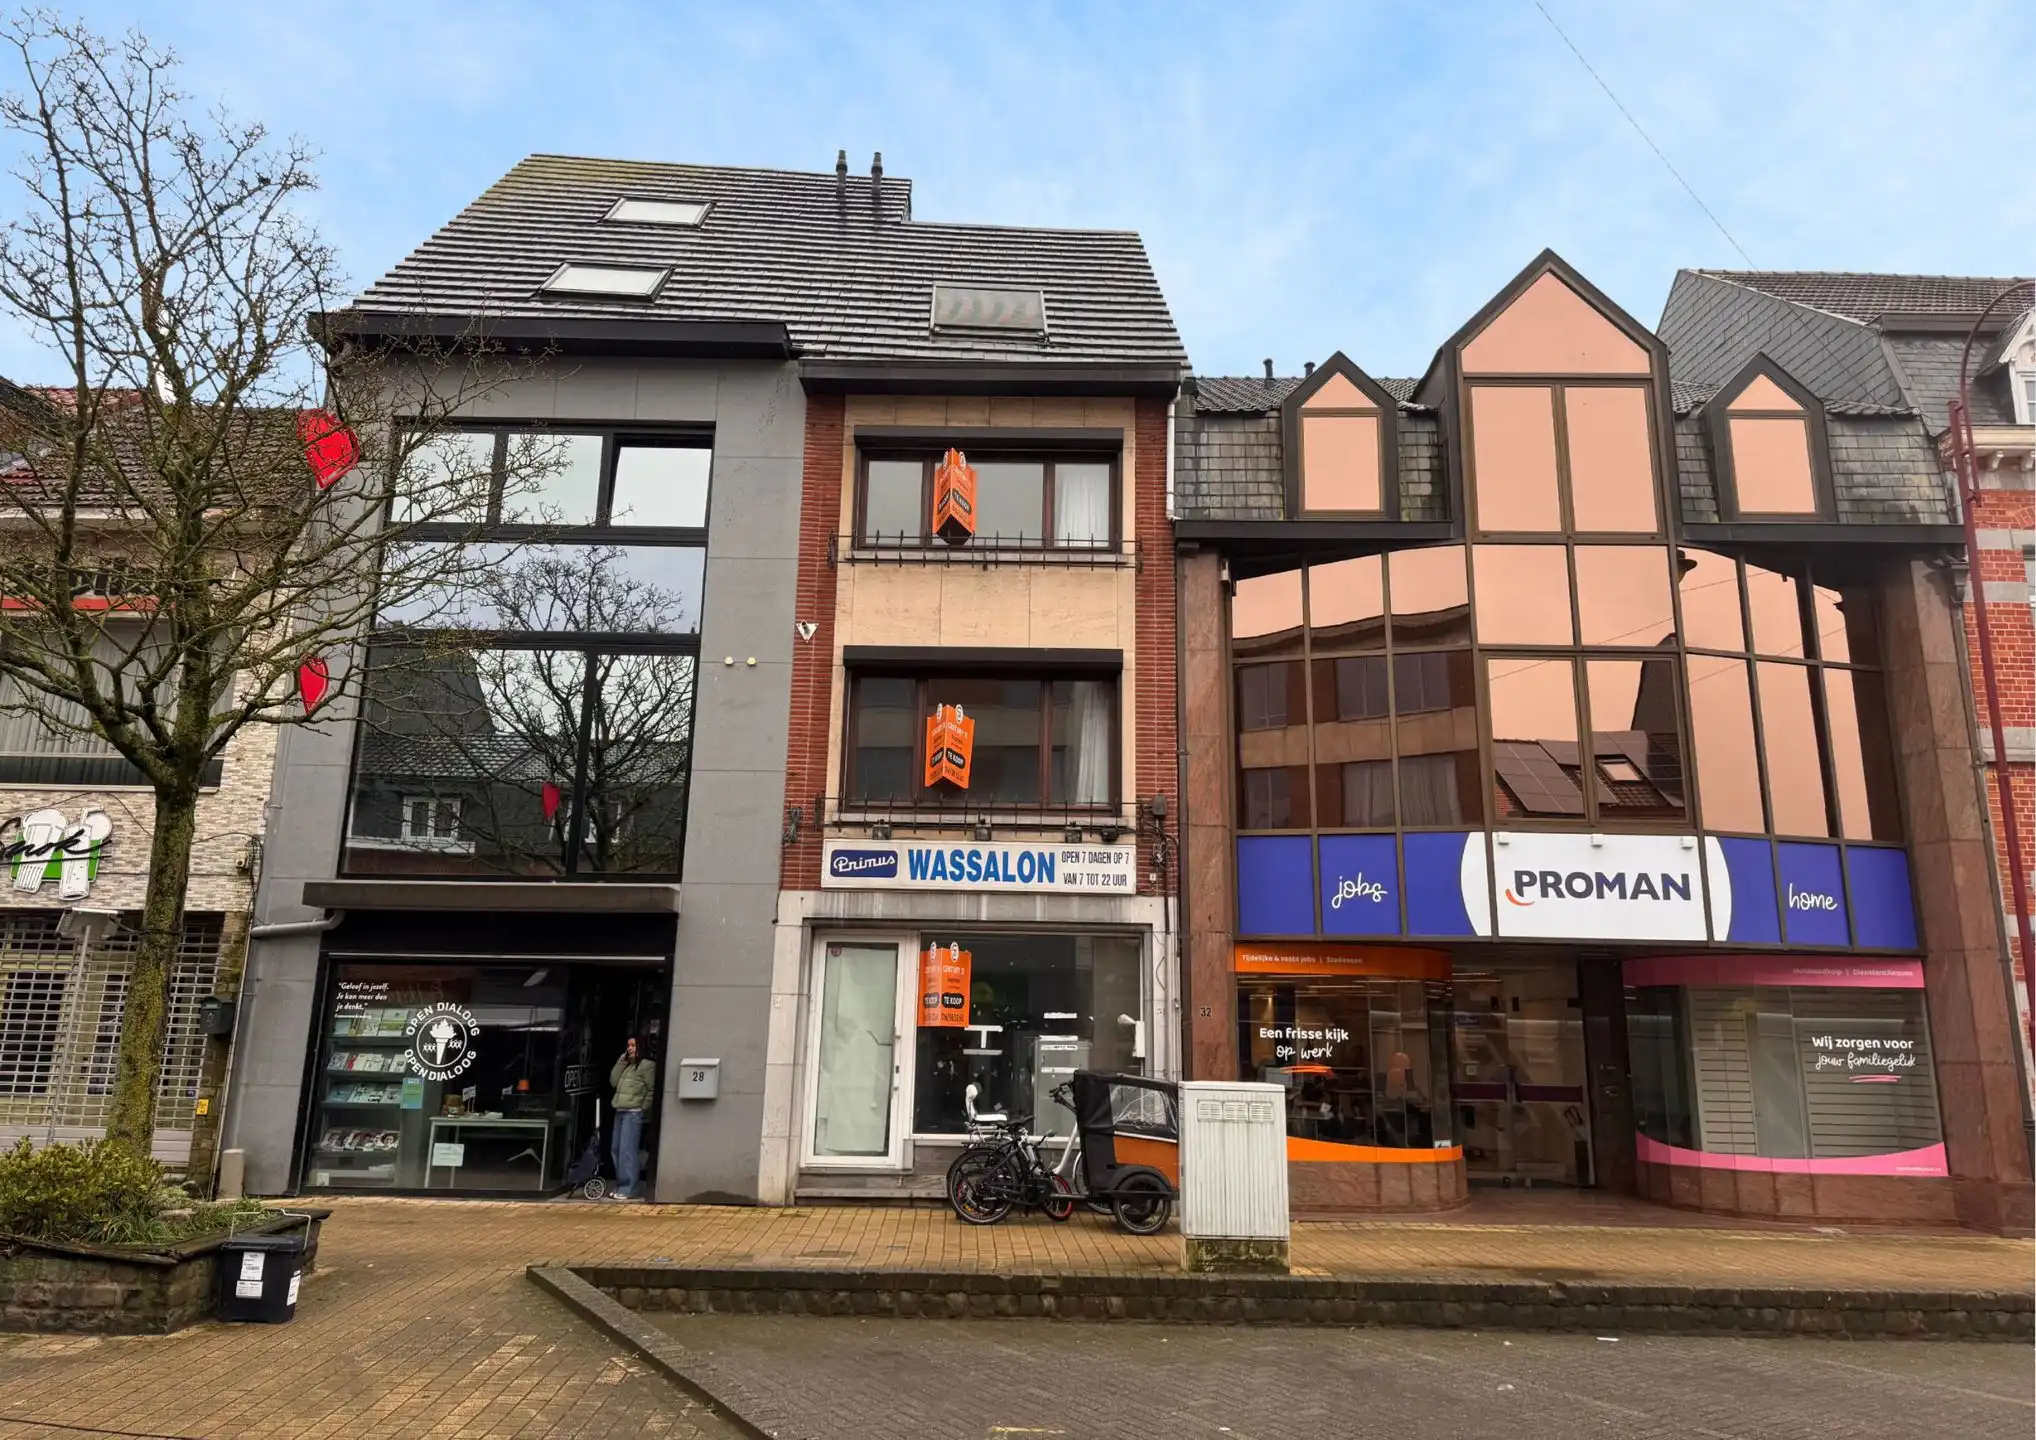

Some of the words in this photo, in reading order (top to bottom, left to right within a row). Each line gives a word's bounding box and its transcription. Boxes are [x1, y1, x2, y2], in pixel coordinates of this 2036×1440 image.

[833, 855, 896, 873] Primus
[908, 848, 1056, 883] WASSALON
[1061, 850, 1080, 864] OPEN
[1082, 851, 1087, 864] 7
[1088, 851, 1112, 864] DAGEN
[1113, 852, 1123, 864] OP
[1125, 852, 1130, 865] 7
[1063, 873, 1077, 885] VAN
[1079, 873, 1084, 885] 7
[1086, 873, 1100, 886] TOT
[1101, 874, 1111, 886] 22
[1112, 874, 1128, 887] UUR
[1514, 870, 1692, 901] PROMAN
[1331, 871, 1389, 909] jobs
[1788, 882, 1838, 911] home
[336, 992, 344, 1000] Je
[943, 996, 950, 1005] TE
[950, 996, 962, 1005] KOOP
[335, 1002, 343, 1012] je
[1200, 1007, 1211, 1017] 32
[406, 1005, 434, 1036] OPEN
[437, 1002, 480, 1037] DIALOOG
[1259, 1027, 1283, 1039] Een
[1285, 1027, 1323, 1040] frisse
[1325, 1028, 1349, 1043] kijk
[1812, 1035, 1833, 1050] Wij
[1835, 1037, 1881, 1051] zorgen
[1883, 1038, 1914, 1049] voor
[1276, 1045, 1296, 1061] op
[1300, 1043, 1333, 1060] werk
[404, 1049, 429, 1078] OPEN
[428, 1050, 477, 1081] DIALOOG
[1815, 1052, 1845, 1070] jouw
[1847, 1052, 1916, 1072] familiegeluk
[692, 1071, 704, 1082] 28
